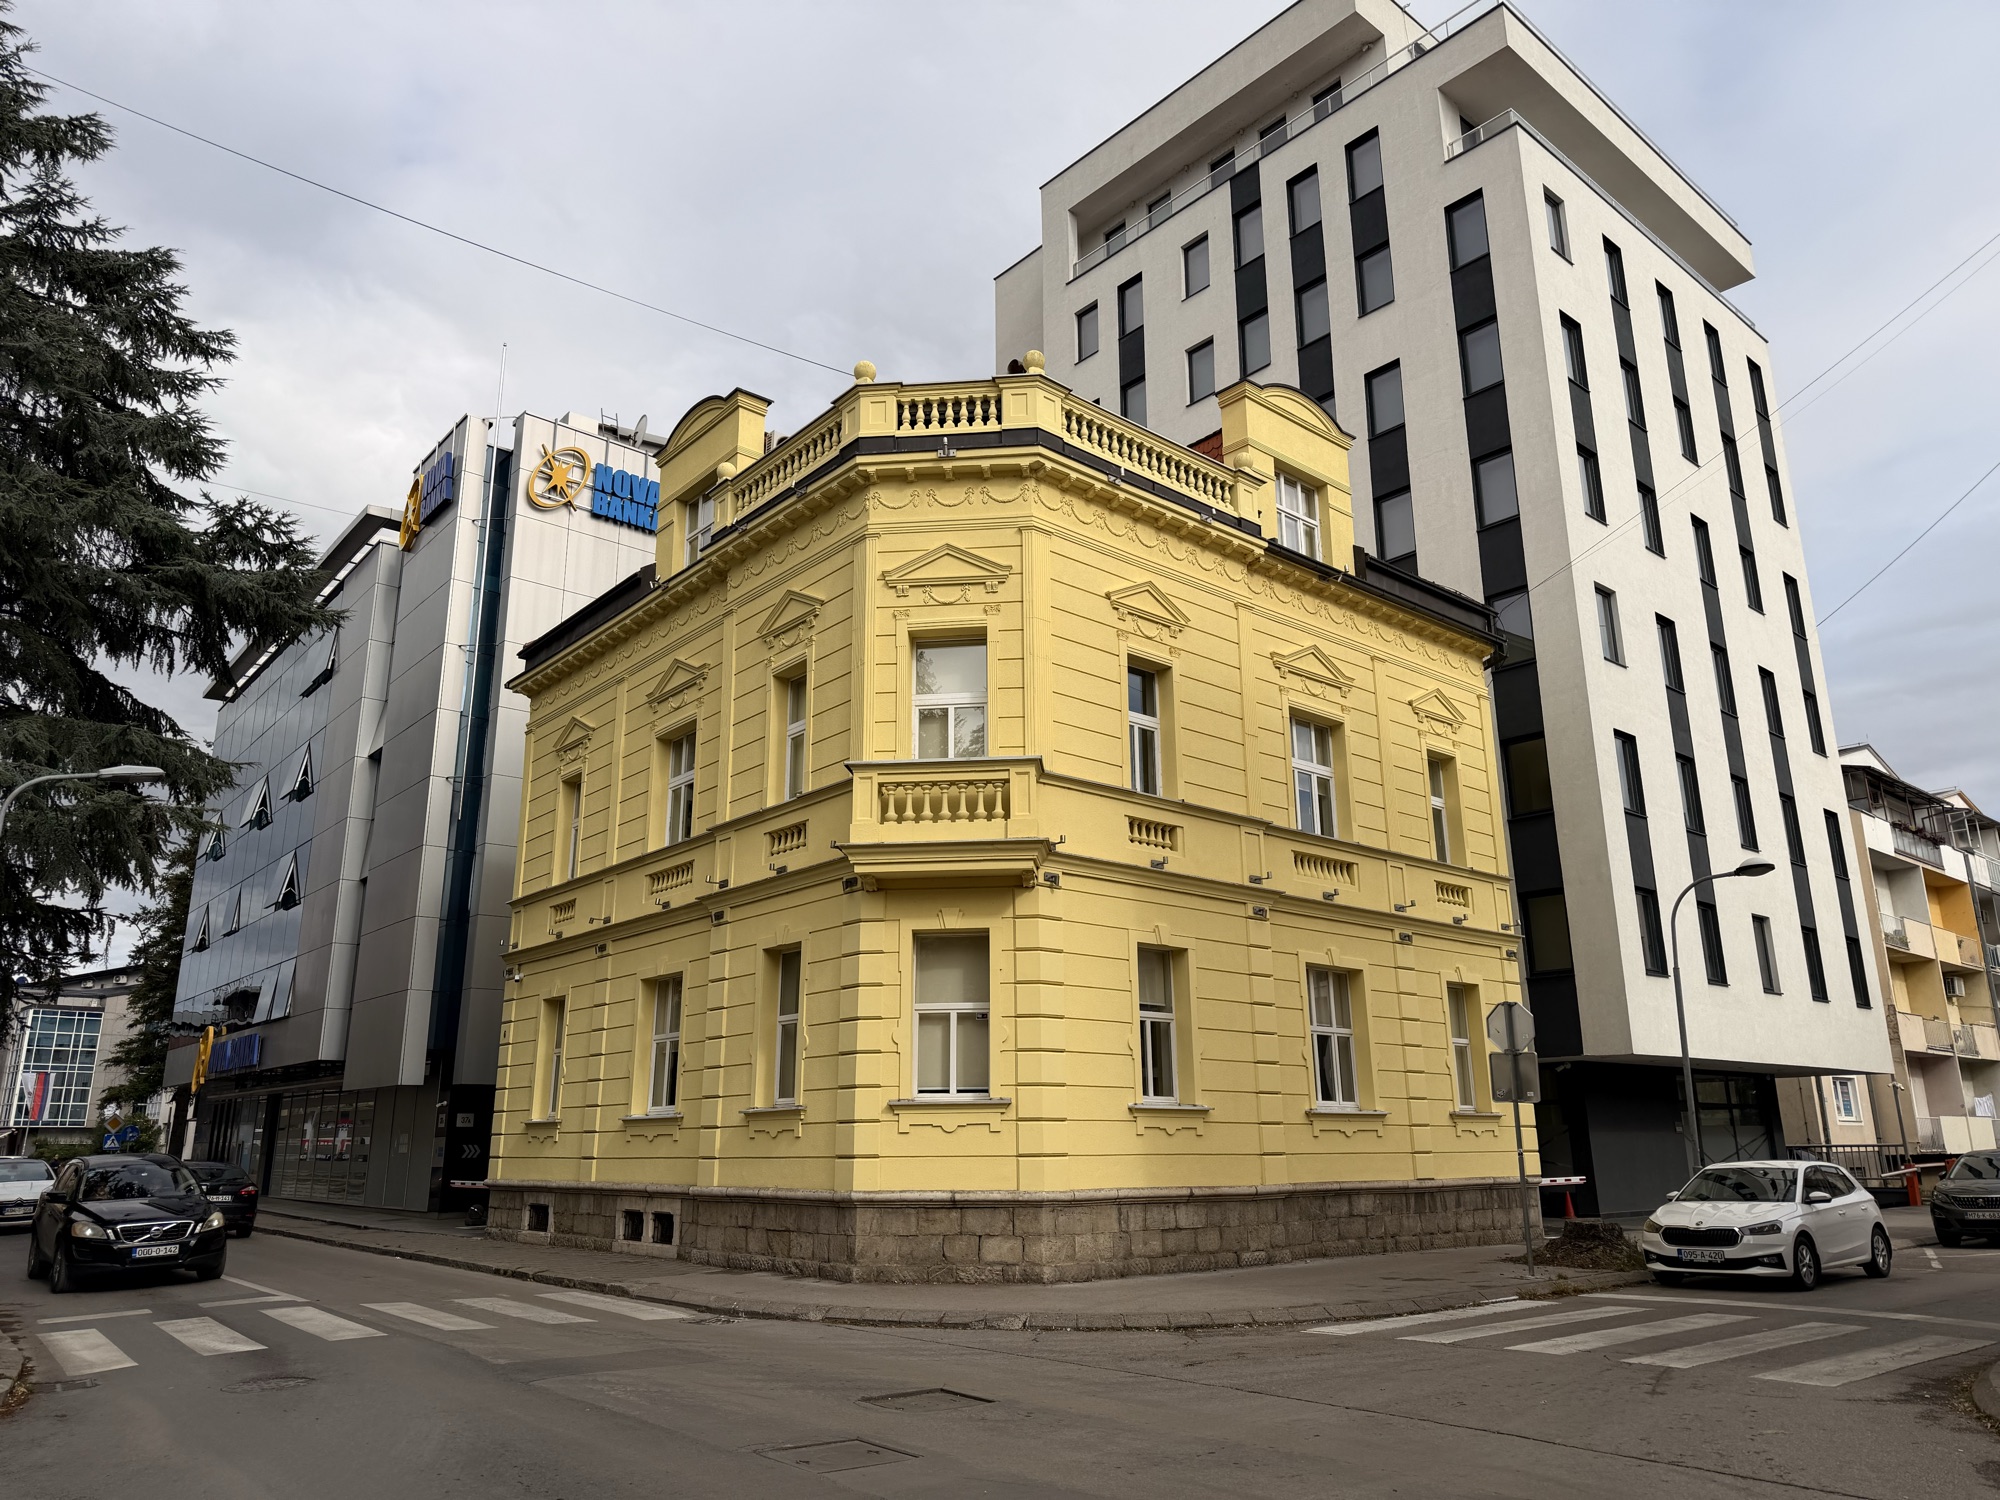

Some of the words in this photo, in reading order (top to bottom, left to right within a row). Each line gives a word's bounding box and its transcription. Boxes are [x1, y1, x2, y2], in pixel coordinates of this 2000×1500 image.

[421, 452, 453, 501] NOVA
[594, 462, 660, 508] NOVA
[419, 477, 453, 523] BANKA
